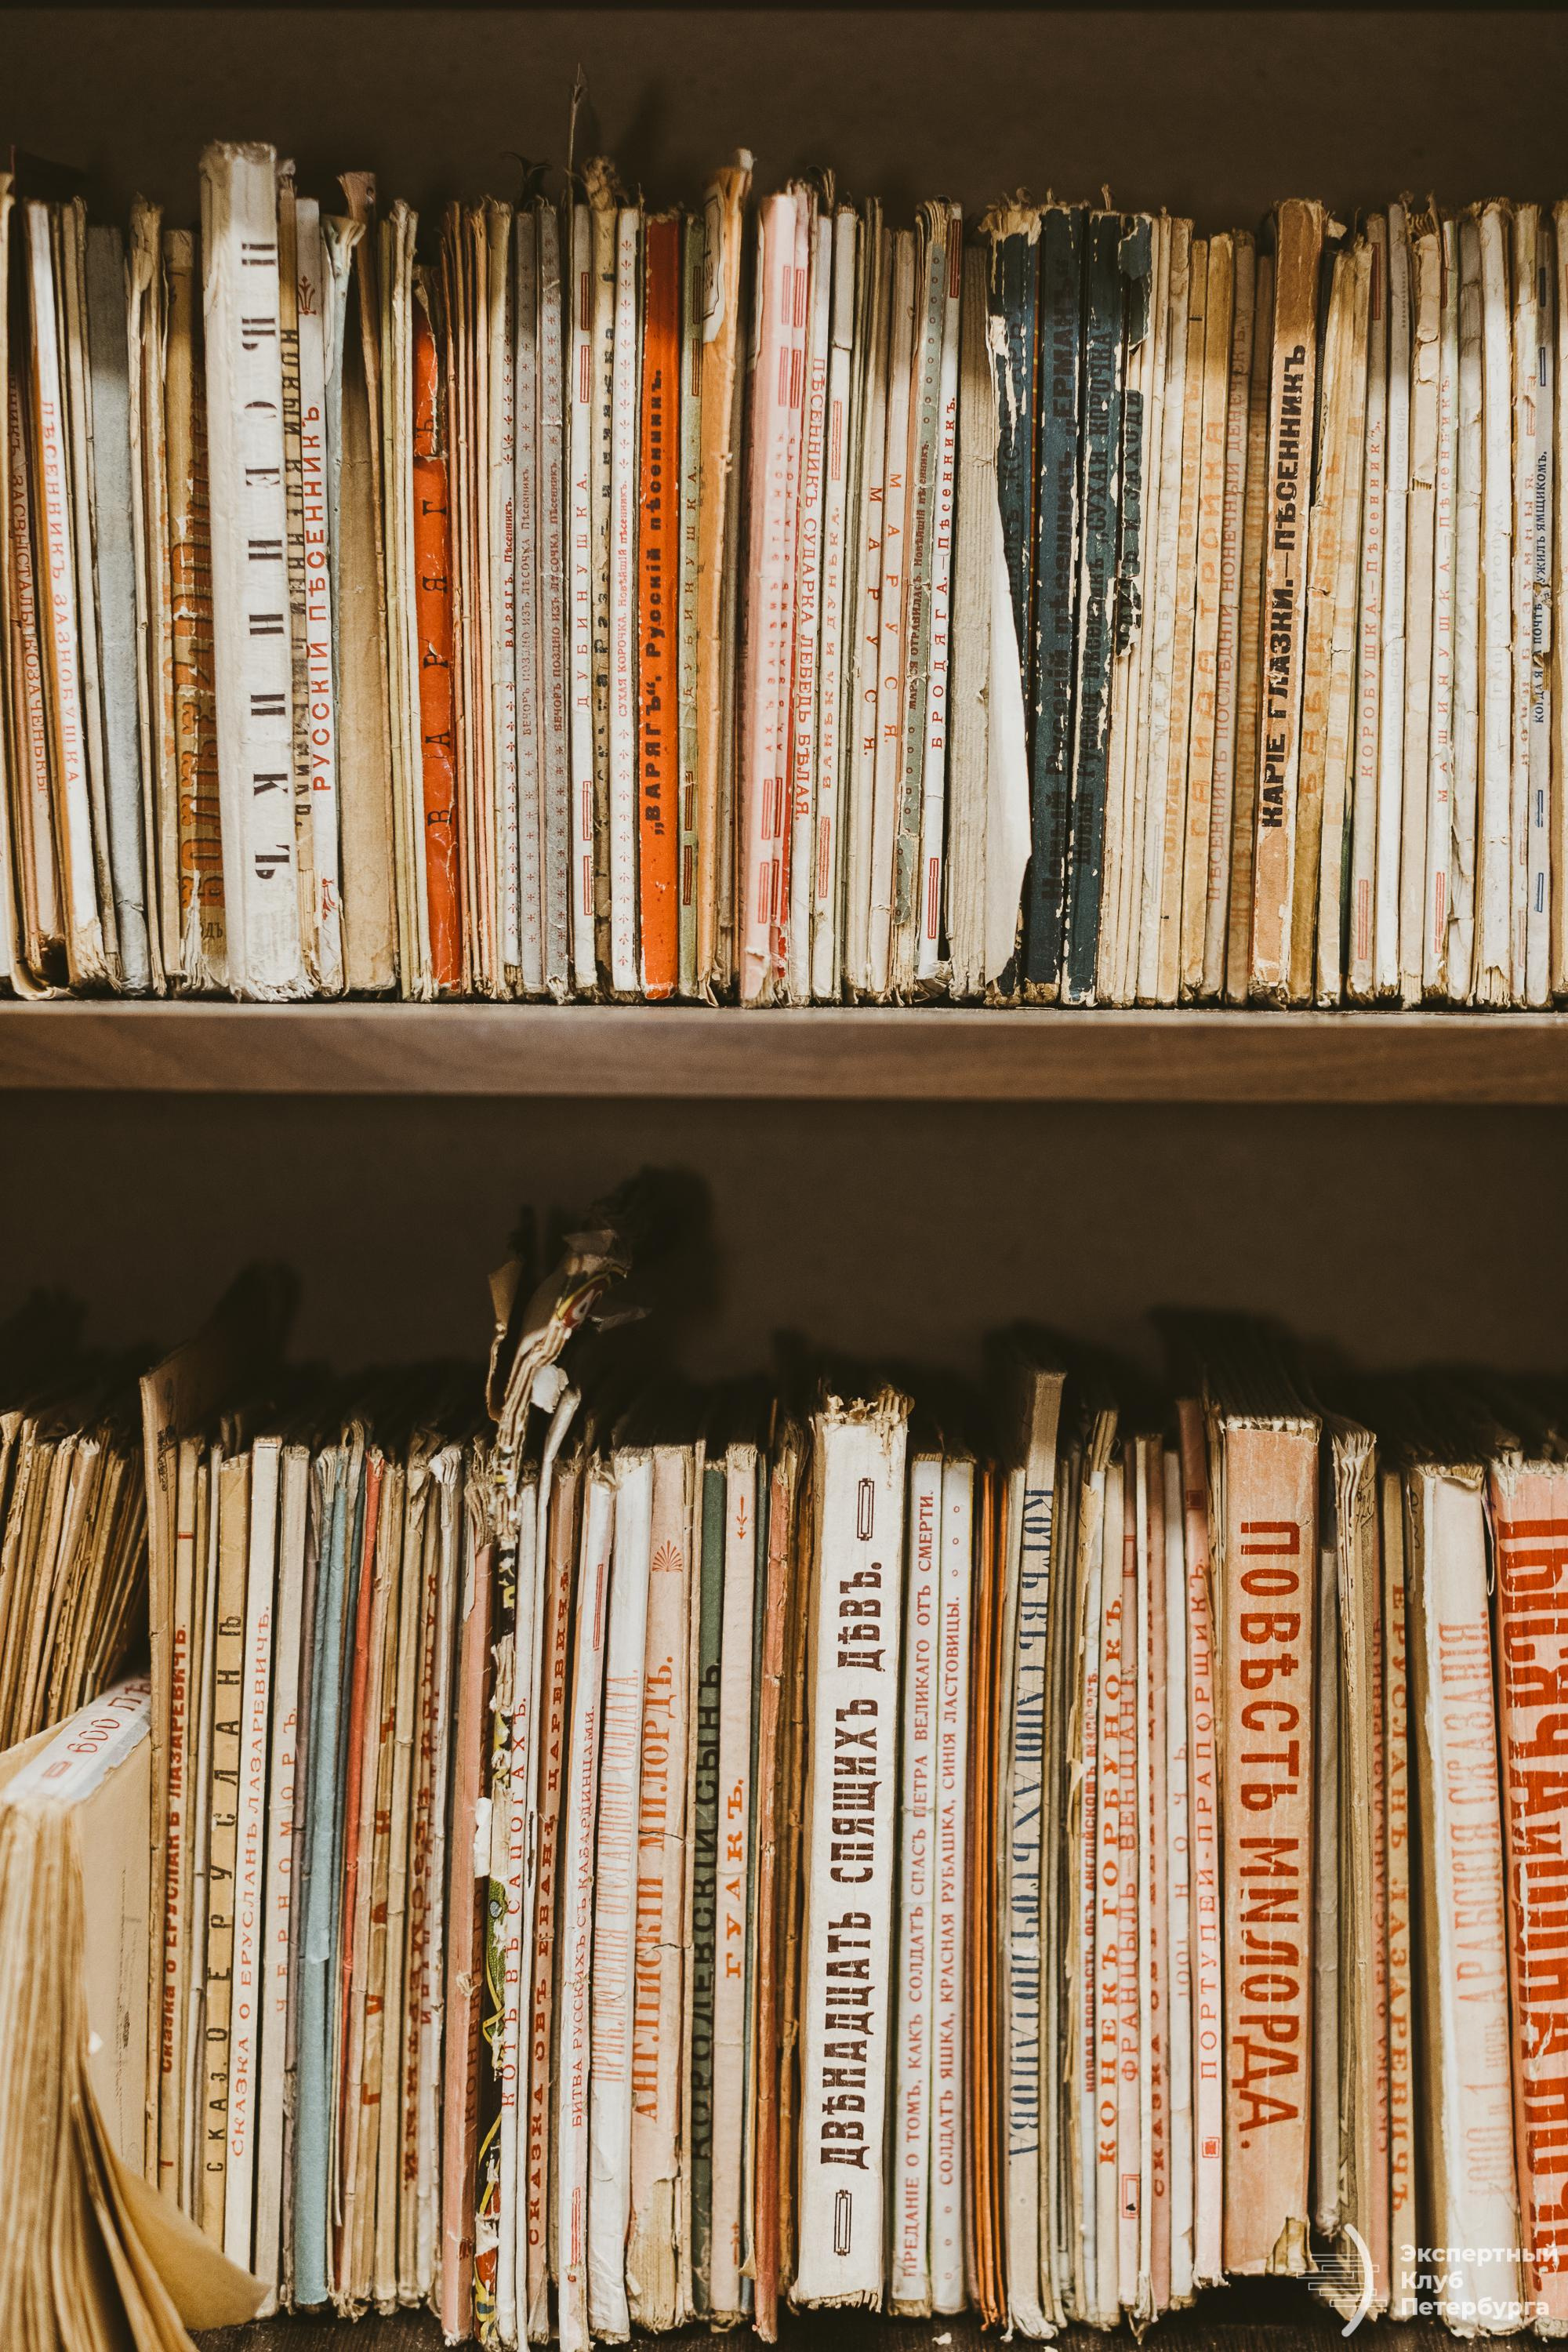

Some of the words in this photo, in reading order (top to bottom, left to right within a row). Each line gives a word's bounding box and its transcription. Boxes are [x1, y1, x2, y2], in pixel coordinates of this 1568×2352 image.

[646, 369, 662, 531] пѣсенникъ.
[773, 433, 785, 497] НОЧЬ.
[804, 357, 826, 507] ПѢСЕННИКЪ
[938, 397, 956, 550] Пѣсенникъ.
[1273, 343, 1306, 551] ПѢСЕННИКЪ
[42, 401, 64, 579] ПѢСЕННИКЪ
[302, 406, 327, 621] ПѢСЕННИКЪ
[502, 496, 514, 564] Пѣсенникъ.
[547, 459, 560, 524] Пѣсенникъ.
[618, 479, 629, 544] пѣсенникъ.
[771, 518, 782, 561] ЭТА
[913, 509, 926, 567] Новѣйшій
[1199, 421, 1223, 621] ТРОЙКА
[1365, 420, 1381, 573] Пѣсенникъ.
[1535, 450, 1549, 532] ЯМЩИКОМЪ.
[241, 243, 291, 880] ПѢСЕННИКЪ
[504, 573, 514, 648] ВАРЯГЪ.
[550, 597, 561, 621] ИЗЪ
[575, 473, 590, 707] ДУБИНУШКА.
[616, 548, 628, 607] Новѣйшій
[646, 547, 666, 658] Русскій
[682, 466, 698, 699] ДУБИНУШКА.
[800, 517, 818, 622] СУДАРКА
[825, 506, 840, 631] ДУНЬКА.
[883, 473, 902, 744] МАРУСЯ.
[414, 419, 452, 826] ВАРЯГЪ
[520, 601, 532, 626] ИЗЪ
[550, 626, 563, 677] ПОЗДНО
[617, 612, 628, 673] КОРОЧКА.
[766, 582, 779, 684] ЗАЧѢМЪ
[824, 641, 835, 656] И
[863, 487, 883, 757] МАРУСЯ.
[1533, 603, 1544, 645] ПОЧТѢ
[307, 641, 331, 791] РУССКІЙ
[552, 683, 564, 731] ВЕЧОРЪ
[617, 677, 628, 717] СУХАЯ
[798, 633, 815, 722] ЛЕБЕДЬ
[1532, 683, 1546, 724] КОГДА
[1534, 670, 1544, 679] Я
[794, 734, 811, 822] БѢЛАЯ.
[822, 670, 834, 789] ВАНЬКА
[1261, 734, 1286, 827] КАРІЕ
[1207, 750, 1229, 901] ПѢСЕННИКЪ
[917, 1490, 934, 1572] СМЕРТИ.
[835, 1561, 886, 1672] ДѢВЪ.
[916, 1584, 932, 1627] ОТЪ
[914, 1639, 931, 1741] ВЕЛИКАГО
[944, 1595, 961, 1724] ЛАСТОВИЦЫ.
[1239, 1519, 1301, 1811] ПОВѢСТЬ
[1438, 1610, 1497, 1805] СКАЗАНІЯ.
[601, 1669, 640, 1770] СОЛДАТА.
[638, 1656, 677, 1852] МИЛОРДЪ.
[942, 1732, 956, 1790] СИНІЯ
[1100, 1592, 1123, 1918] ГОРБУНОКЪ.
[507, 1697, 527, 1915] САПОГАХЪ.
[829, 1698, 883, 1884] СПЯЩИХЪ
[1187, 1559, 1218, 2080] ПОРТУПЕЙ-ПРАПОРЩИКЪ.
[276, 1707, 297, 2013] ЧЕРНОМОРЪ.
[724, 1778, 745, 1979] ГУАКЪ.
[910, 1828, 927, 1896] СПАСЪ
[941, 1798, 957, 1904] РУБАШКА,
[506, 1936, 519, 1984] ВЪ
[576, 1896, 587, 1927] СЪ
[909, 1905, 925, 2002] СОЛДАТЪ
[940, 1912, 955, 2003] КРАСНАЯ
[1450, 1818, 1507, 2005] АРАБСКІЯ
[163, 1958, 176, 1974] о
[238, 2002, 251, 2020] О
[572, 1934, 586, 2049] РУССКИХЪ
[591, 1928, 627, 2082] ПРИКЛЮЧЕНІЯ
[1229, 1837, 1301, 2151] МИЛОРДА.
[161, 1984, 176, 2073] Сказка
[502, 2008, 518, 2107] КОТЪ
[819, 1911, 876, 2170] ДВѢНАДЦАТЬ
[907, 2013, 924, 2069] КАКЪ
[940, 2012, 957, 2080] ЯШКА,
[1098, 1943, 1119, 2165] КОНЕКЪ
[205, 2061, 229, 2172] СКАЗ.
[231, 2037, 249, 2157] СКАЗКА
[570, 2058, 583, 2128] БИТВА
[906, 2078, 924, 2143] ТОМЪ,
[939, 2089, 955, 2186] СОЛДАТЪ
[528, 2083, 545, 2246] СКАЗКА
[906, 2153, 920, 2167] О
[902, 2177, 920, 2277] ПРЕДАНІЕ
